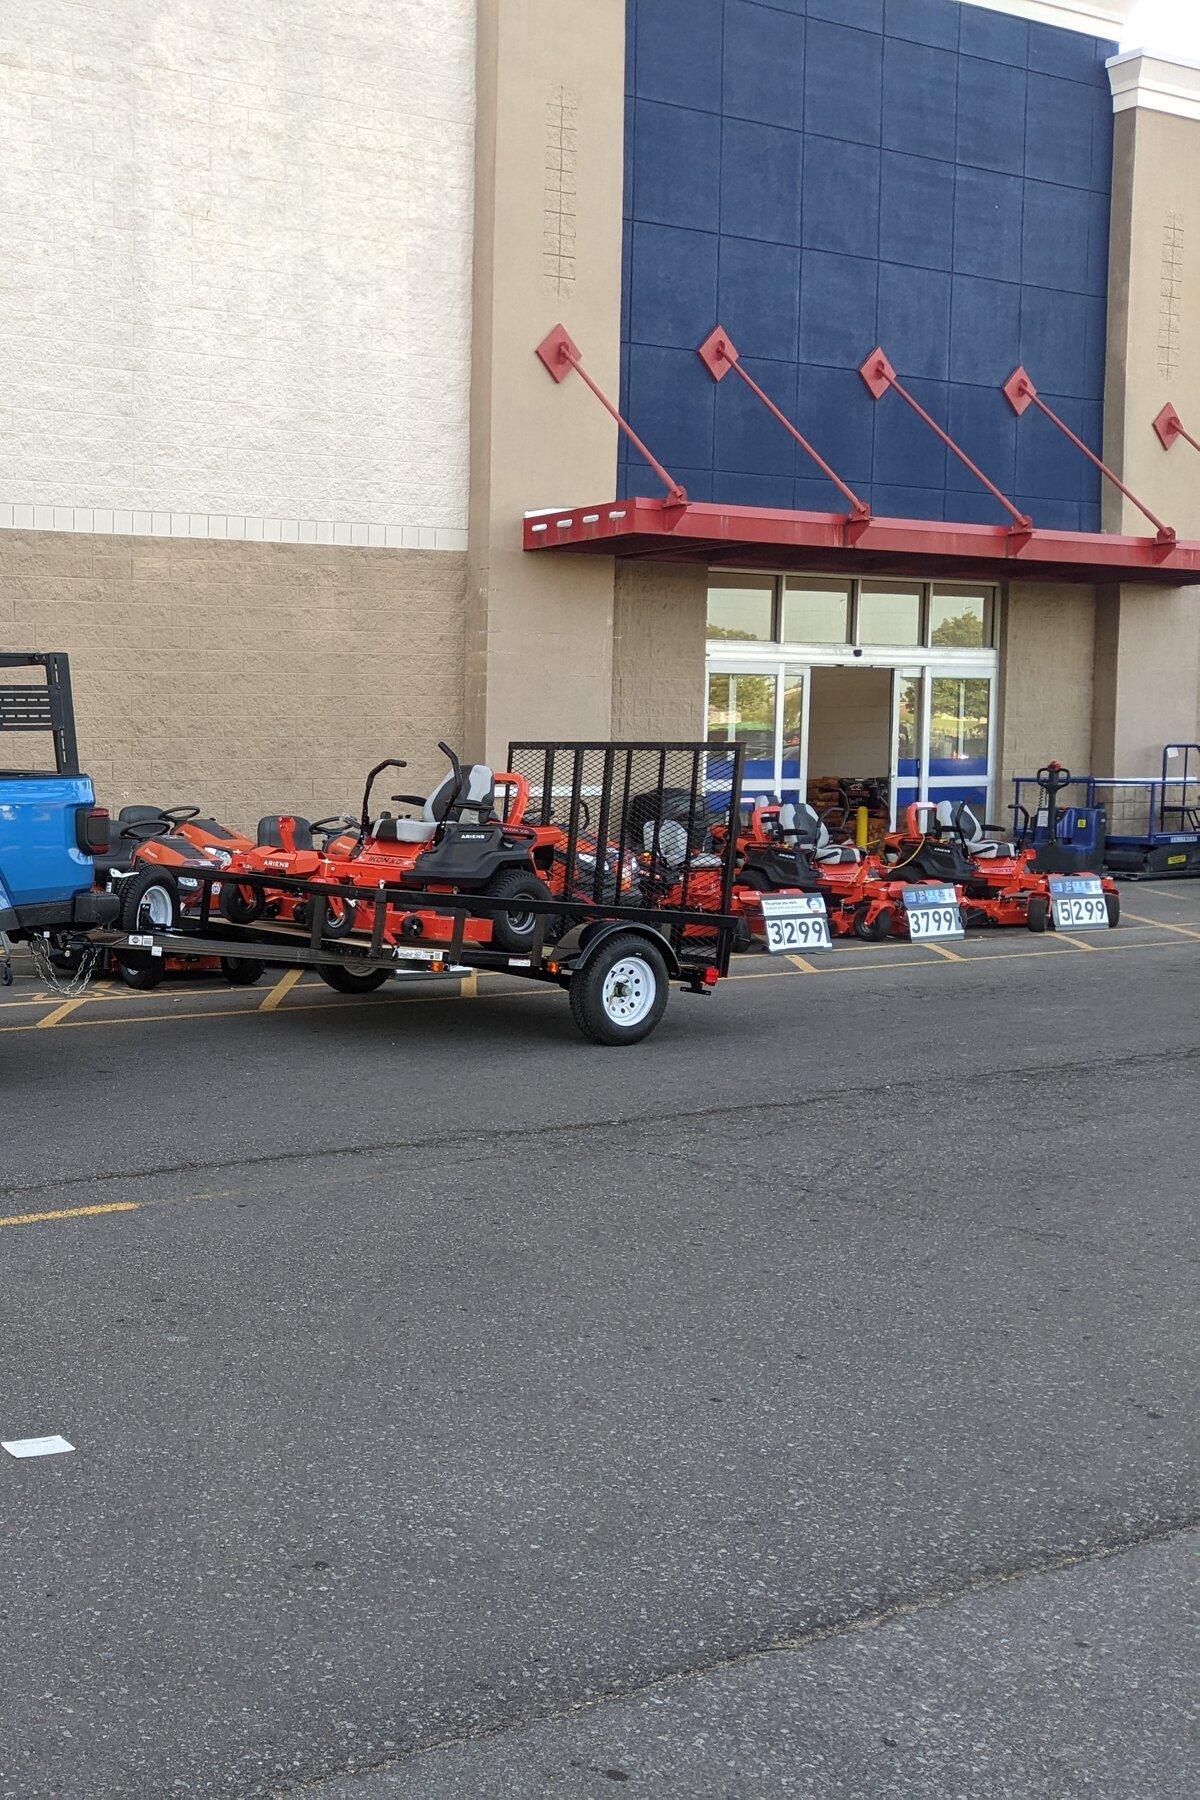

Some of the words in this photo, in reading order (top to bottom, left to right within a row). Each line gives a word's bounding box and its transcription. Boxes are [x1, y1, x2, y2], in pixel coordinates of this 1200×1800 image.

[263, 860, 290, 868] ARIENS
[1060, 900, 1105, 921] 5299
[770, 920, 823, 945] 3299
[910, 910, 953, 934] 3799
